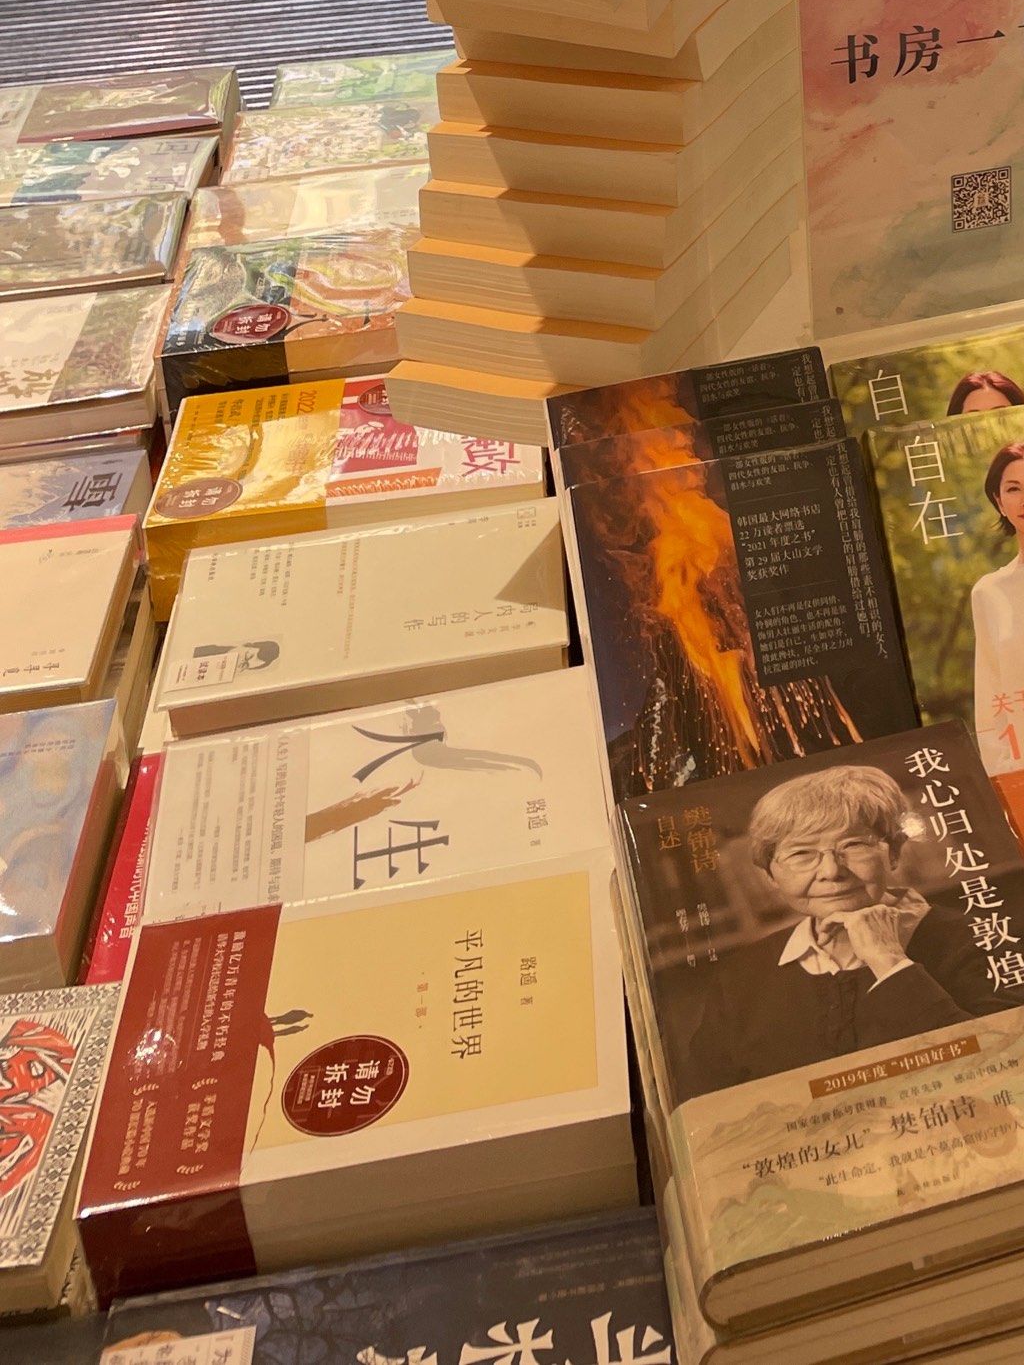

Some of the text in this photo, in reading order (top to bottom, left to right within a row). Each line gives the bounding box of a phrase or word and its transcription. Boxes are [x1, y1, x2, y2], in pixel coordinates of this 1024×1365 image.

[867, 369, 909, 422] 自
[903, 435, 964, 545] 自在
[352, 725, 449, 891] 人生
[525, 798, 550, 830] 路遥
[450, 929, 485, 1060] 平凡的世界
[519, 955, 537, 987] 路遥
[317, 1062, 350, 1109] 拆封
[350, 1059, 381, 1105] 请勿
[742, 1126, 872, 1178] “敦煌的女儿”
[890, 1095, 977, 1141] 樊锦诗
